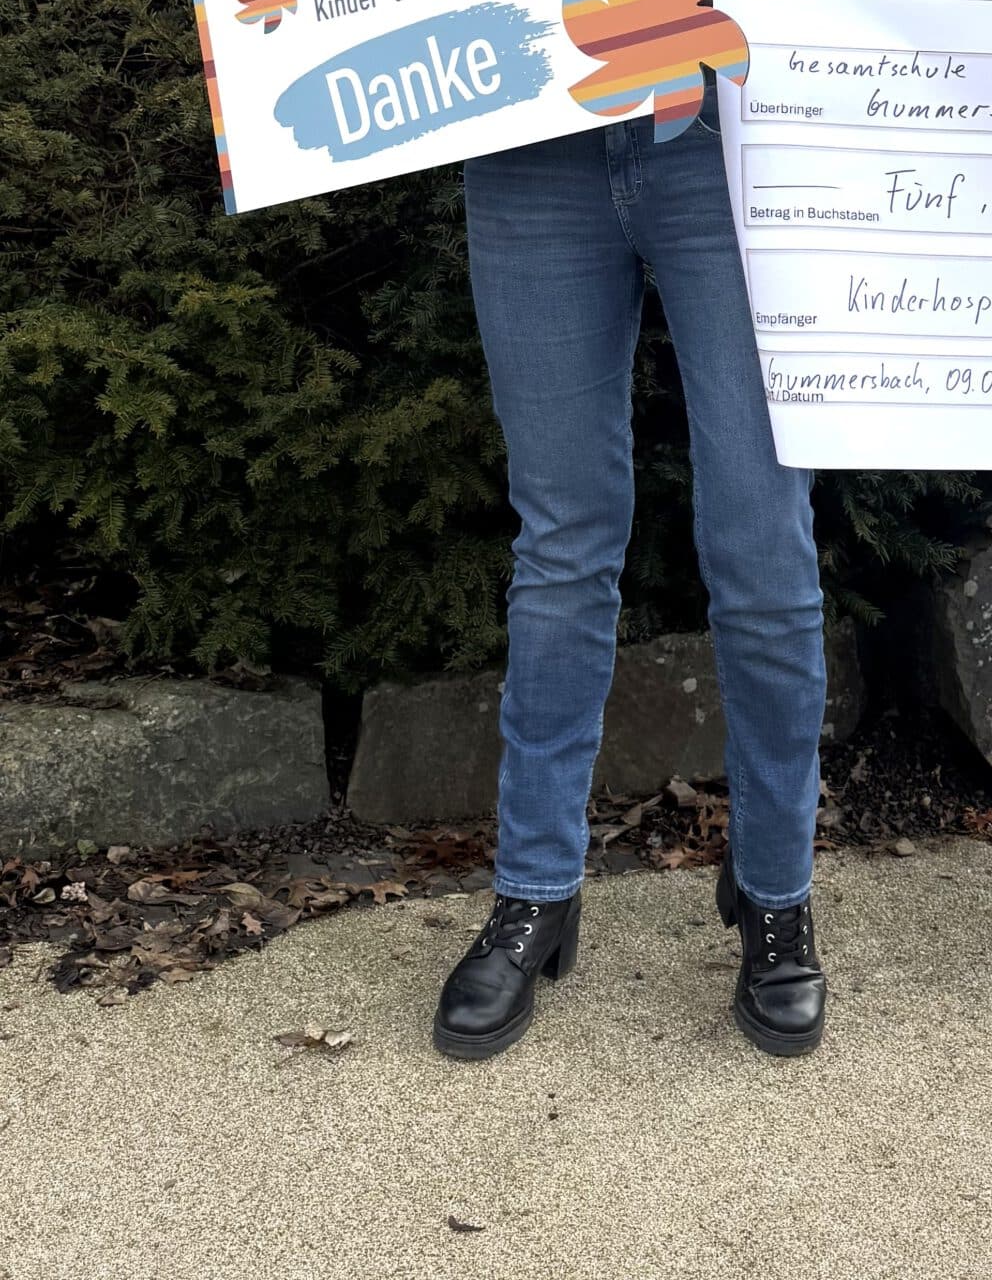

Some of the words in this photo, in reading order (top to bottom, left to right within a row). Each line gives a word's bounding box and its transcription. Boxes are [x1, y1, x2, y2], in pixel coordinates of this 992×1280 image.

[788, 50, 967, 80] Gesamtschule
[325, 35, 502, 146] Danke
[749, 100, 824, 119] Überbringer
[750, 206, 791, 221] Betrag
[793, 205, 805, 218] in
[807, 206, 880, 222] Buchstaben
